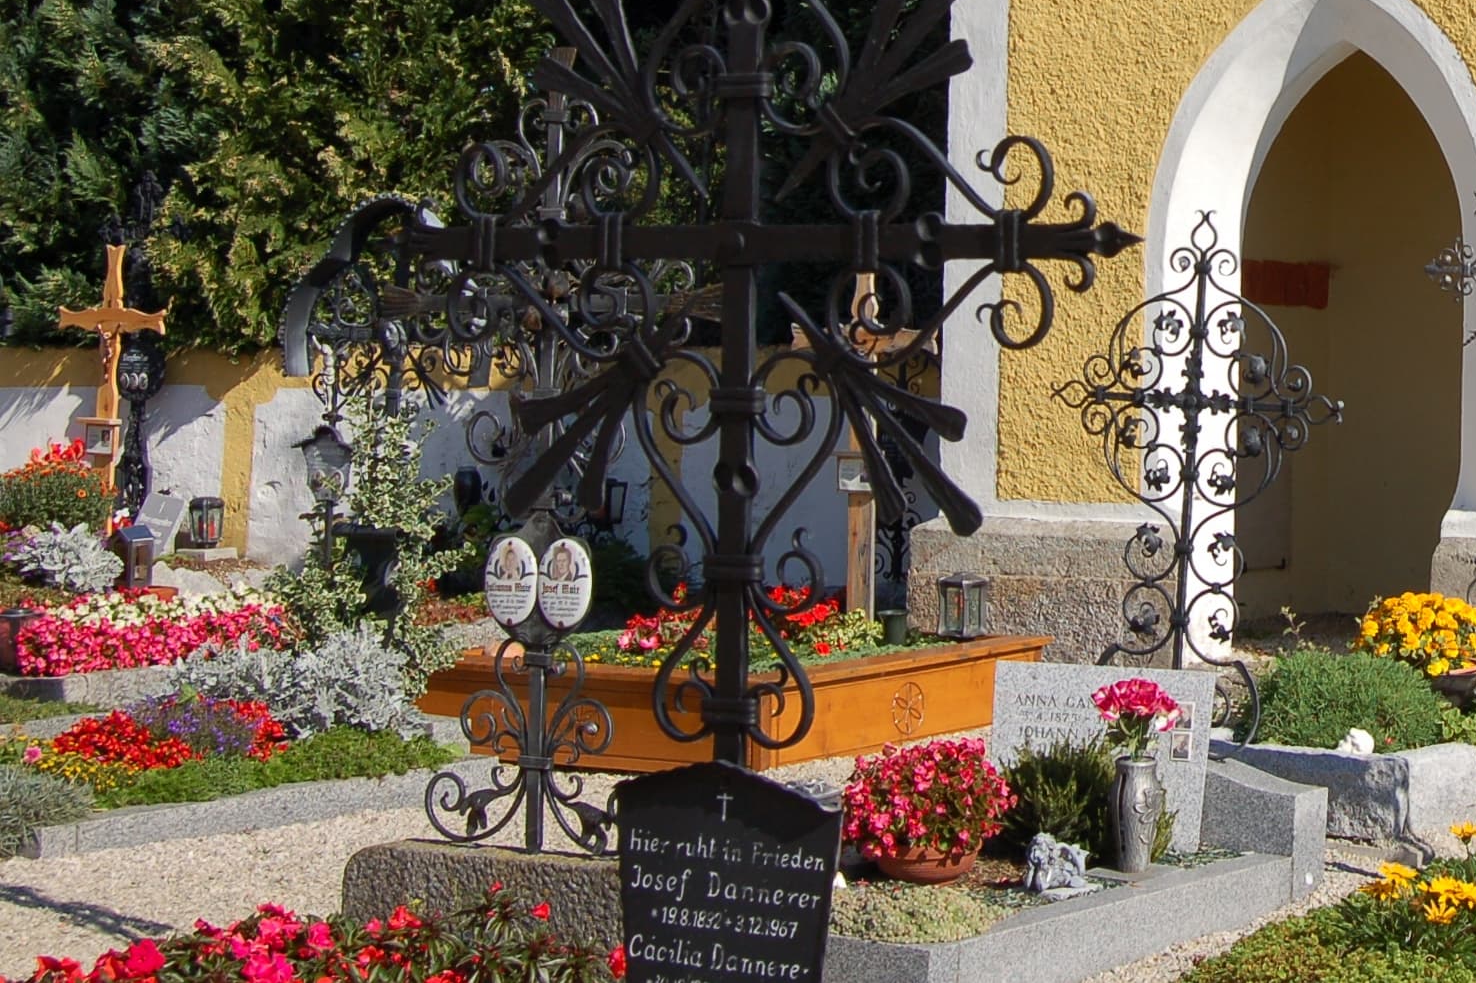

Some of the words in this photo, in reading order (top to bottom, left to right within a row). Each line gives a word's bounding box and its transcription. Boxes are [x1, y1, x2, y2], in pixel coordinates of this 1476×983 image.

[1014, 693, 1057, 708] ANNA
[1019, 726, 1079, 739] JOHANN
[722, 840, 742, 862] in
[752, 842, 825, 871] Frieden
[631, 865, 692, 902] Josef
[707, 871, 821, 909] Dannerer
[710, 943, 810, 979] Dannere
